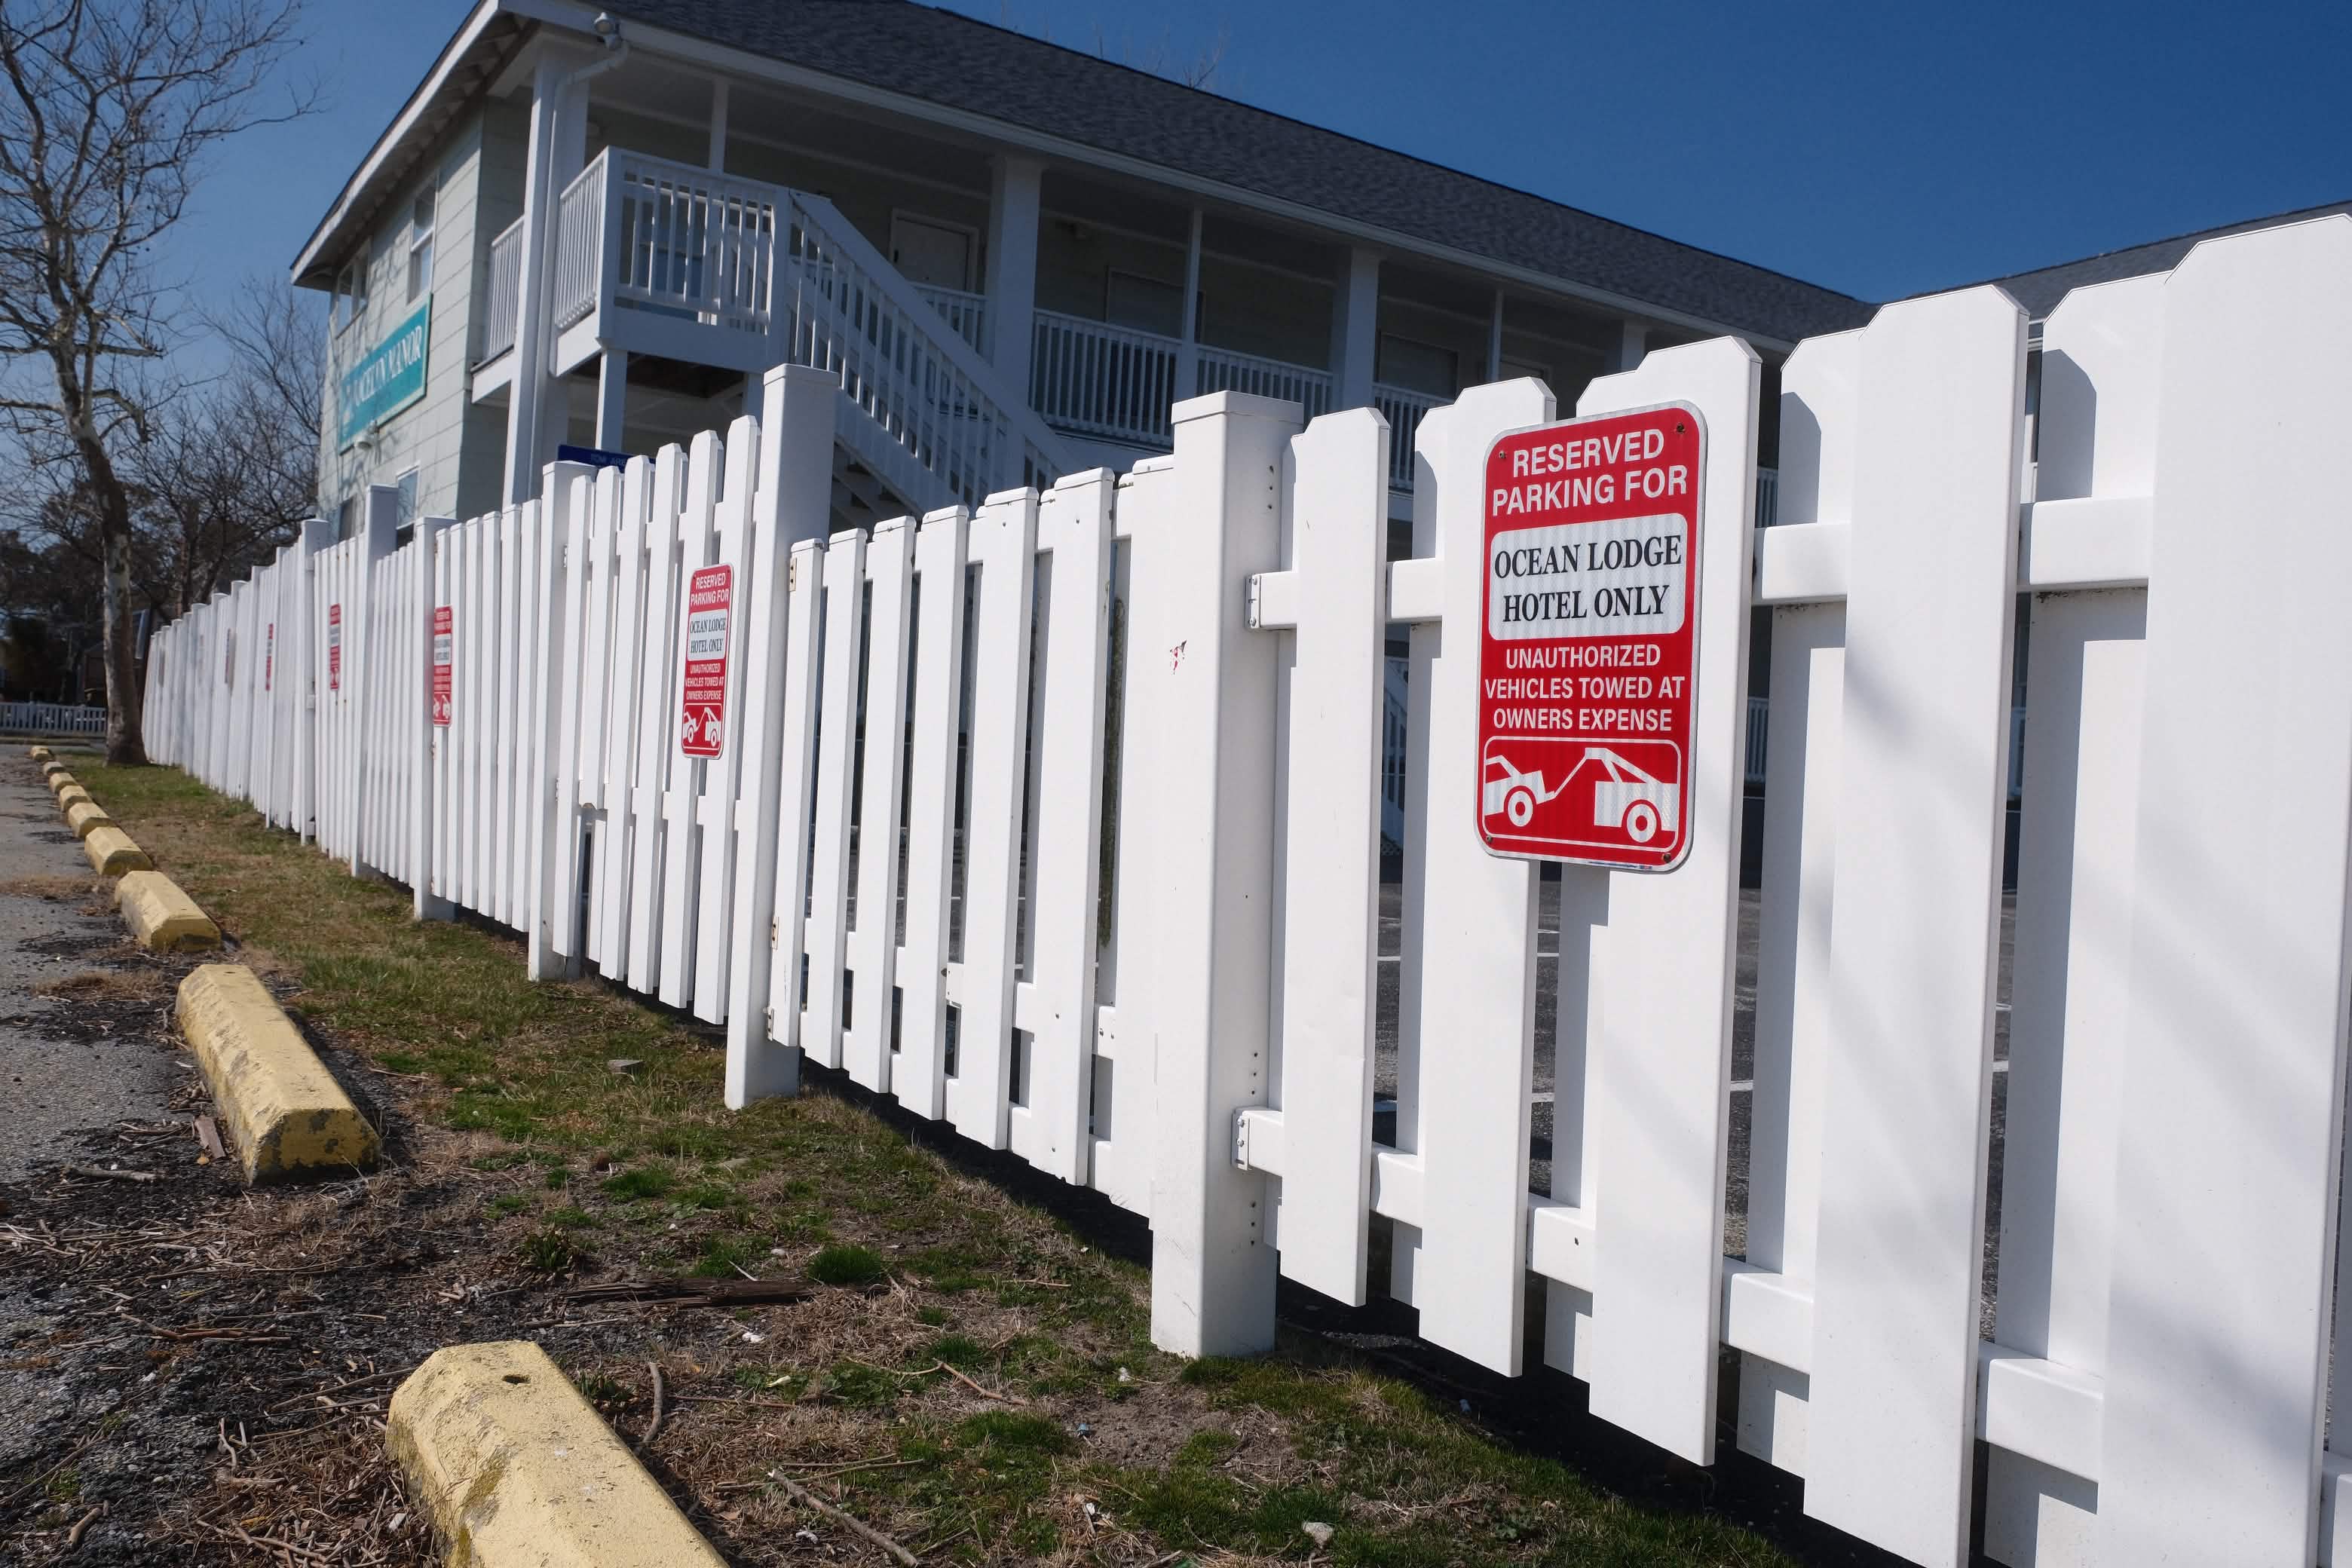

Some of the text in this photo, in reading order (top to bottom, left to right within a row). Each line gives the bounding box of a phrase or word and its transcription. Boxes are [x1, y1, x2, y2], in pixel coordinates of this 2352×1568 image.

[1513, 429, 1664, 478] RESERVED
[1493, 464, 1688, 516] PARKING FOR
[1494, 534, 1682, 579] OCEAN LODGE
[696, 572, 726, 590] RESERVED
[691, 588, 730, 607] PARKING FOR
[1502, 584, 1670, 623] HOTEL ONLY
[690, 617, 726, 634] OCEAN LODGE
[691, 638, 724, 654] HOTEL ONLY
[1506, 644, 1661, 669] UNAUTHORIZED
[690, 663, 721, 675] UNAUTHORIZED
[685, 675, 724, 688] VEHICLES TOWED AT
[1484, 675, 1686, 700] VEHICLES TOWED AT
[687, 690, 722, 700] OWNERS EXPENSE
[1493, 708, 1673, 731] OWNERS EXPENSE
